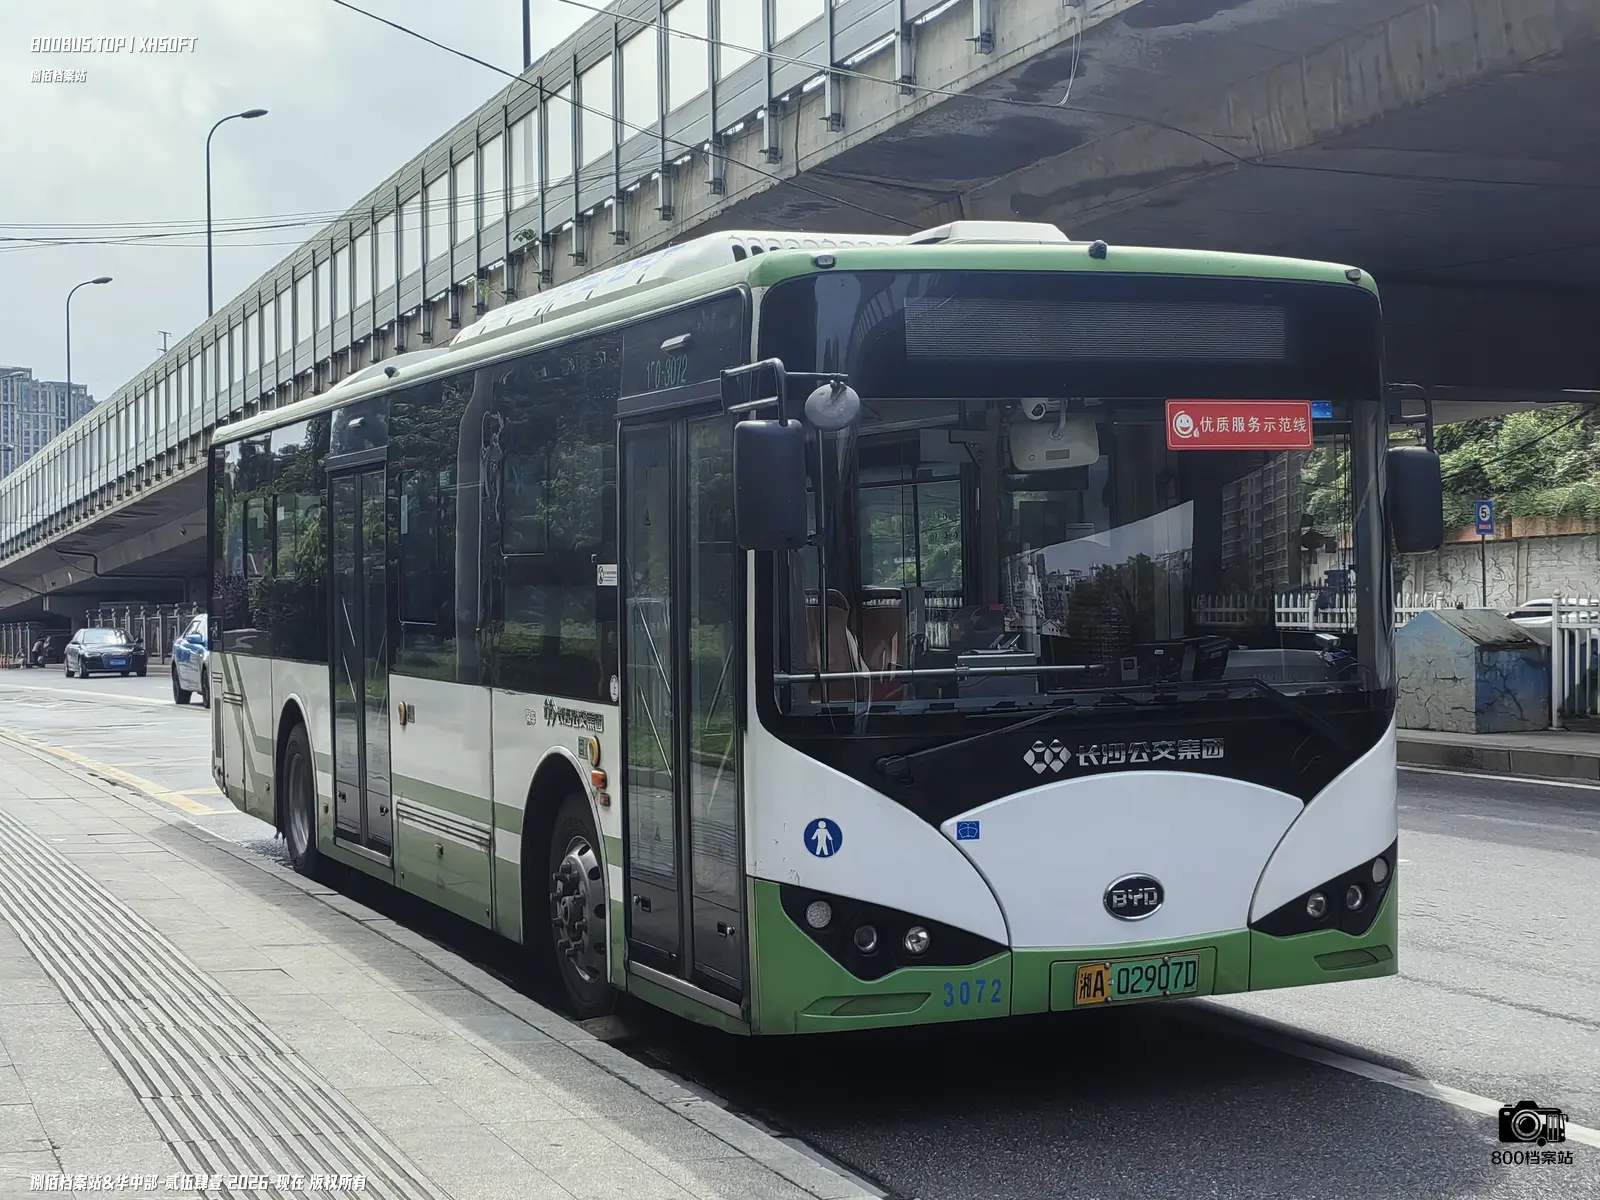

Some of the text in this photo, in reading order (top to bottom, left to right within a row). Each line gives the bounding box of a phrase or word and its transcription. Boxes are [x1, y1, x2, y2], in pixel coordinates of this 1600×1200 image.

[1200, 416, 1307, 433] 优质服务示范线
[1076, 738, 1224, 767] 长沙公交集团
[1112, 887, 1158, 908] BYD
[943, 979, 1002, 1008] 3072
